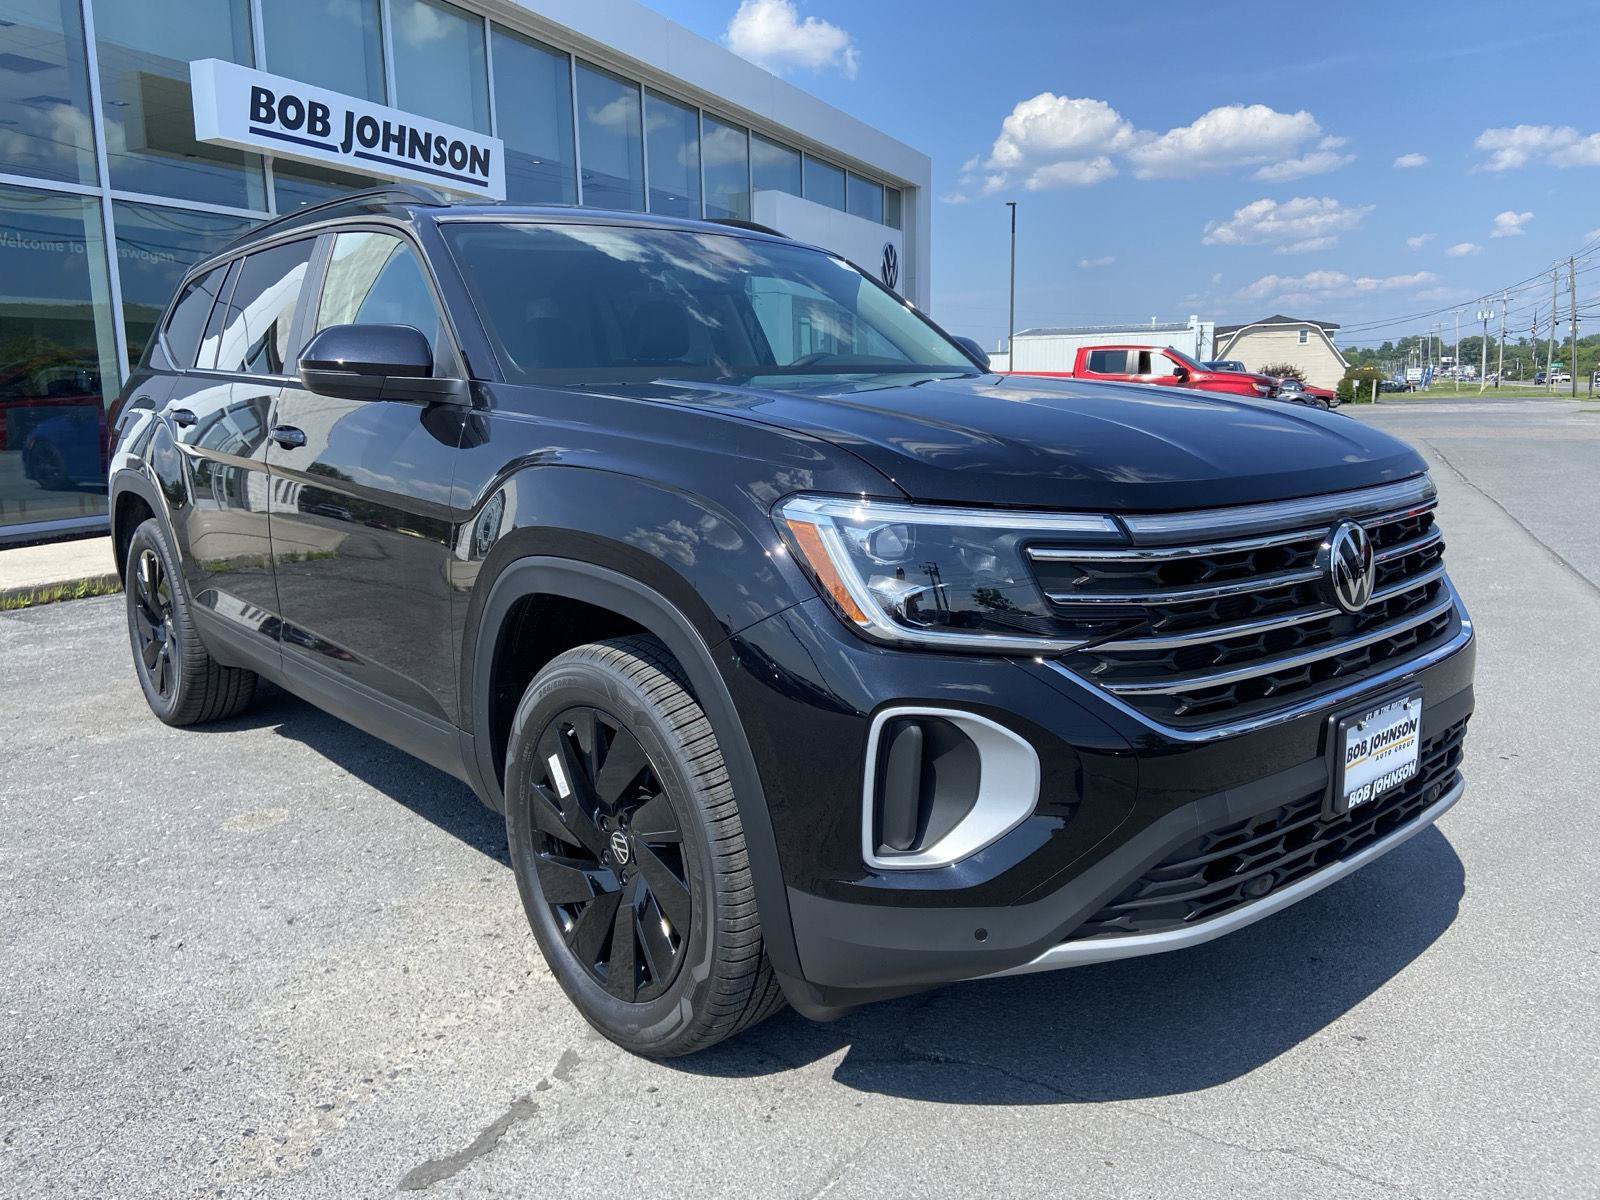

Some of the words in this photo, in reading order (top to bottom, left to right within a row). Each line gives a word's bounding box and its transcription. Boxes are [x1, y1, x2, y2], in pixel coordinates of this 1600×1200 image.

[250, 85, 331, 138] BOB
[339, 110, 491, 178] JOHNSON
[69, 241, 84, 254] to
[1347, 740, 1367, 763] BOB
[1369, 718, 1417, 756] JOHNSON
[1376, 750, 1391, 761] AUTO
[1395, 739, 1414, 752] GROUP
[1348, 785, 1370, 808] BOB
[1371, 761, 1417, 801] JOHNSON
